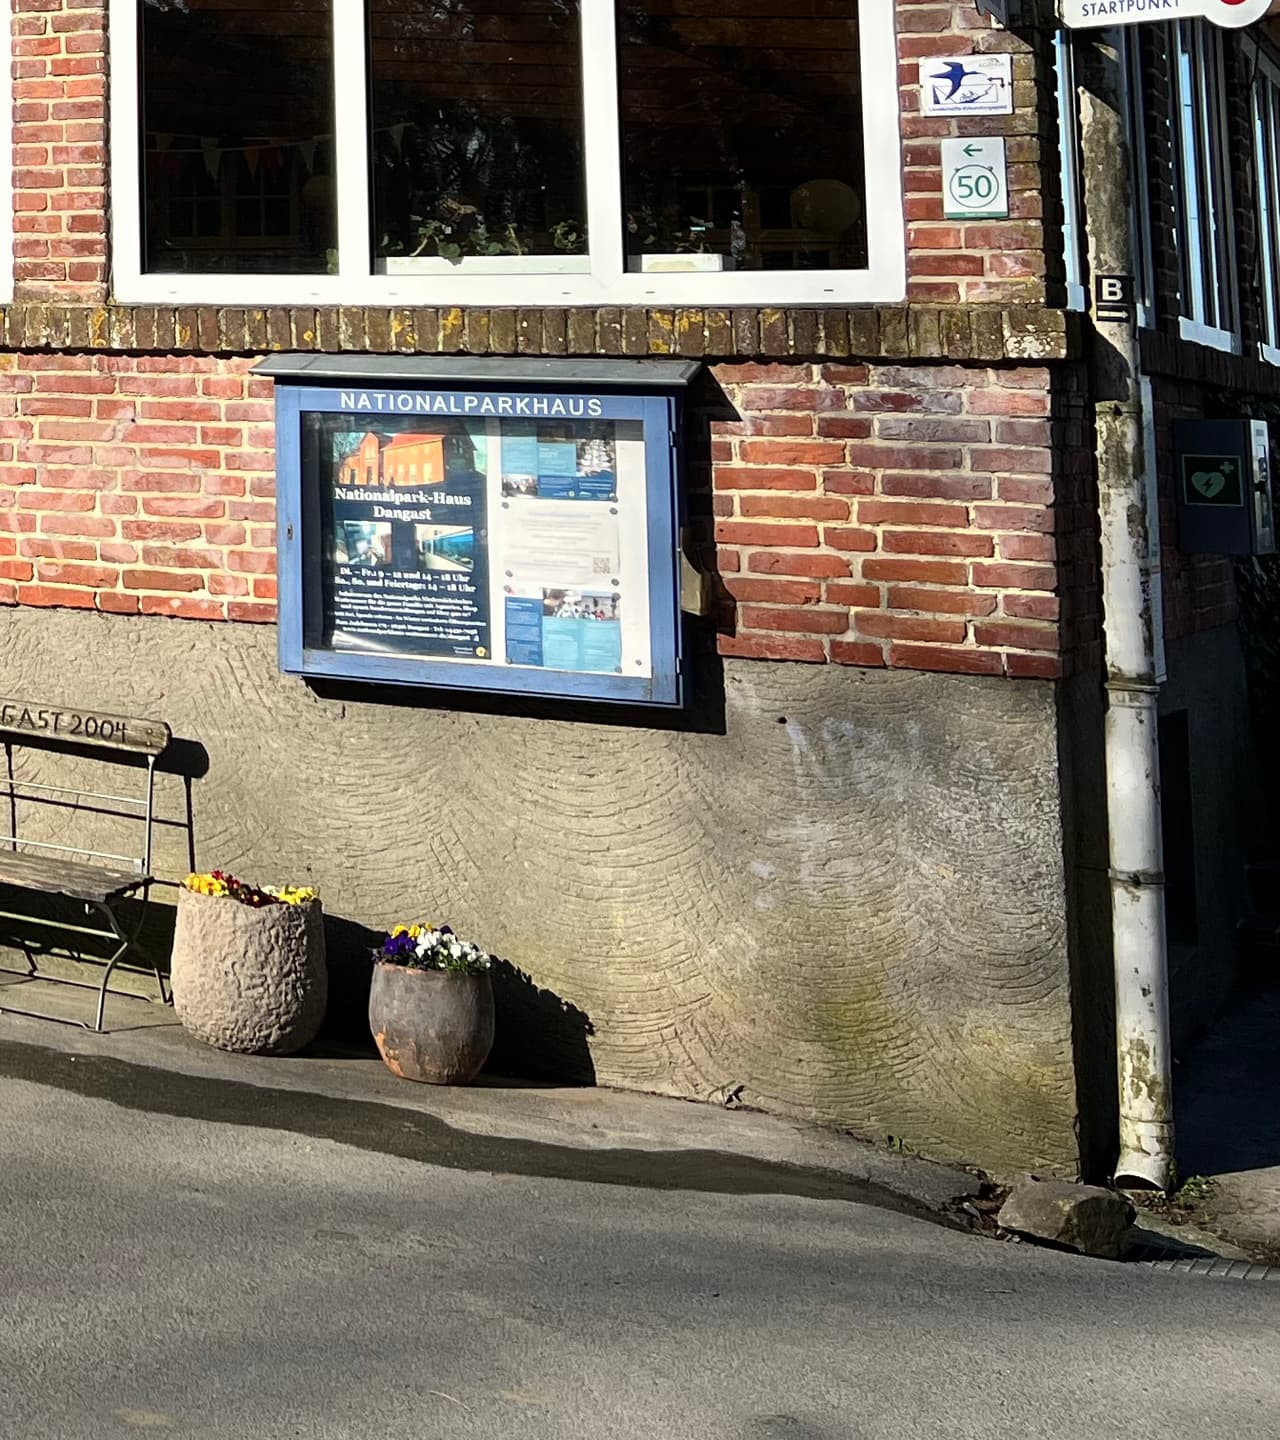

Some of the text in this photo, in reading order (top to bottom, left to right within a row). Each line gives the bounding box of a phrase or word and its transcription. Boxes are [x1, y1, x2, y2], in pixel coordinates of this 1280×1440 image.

[958, 175, 992, 199] 50
[1102, 278, 1123, 301] B
[340, 392, 602, 416] NATIONALPARKHAUS
[334, 487, 472, 505] Nationalpark-Haus
[373, 506, 432, 521] Dangast
[69, 714, 128, 743] 2004
